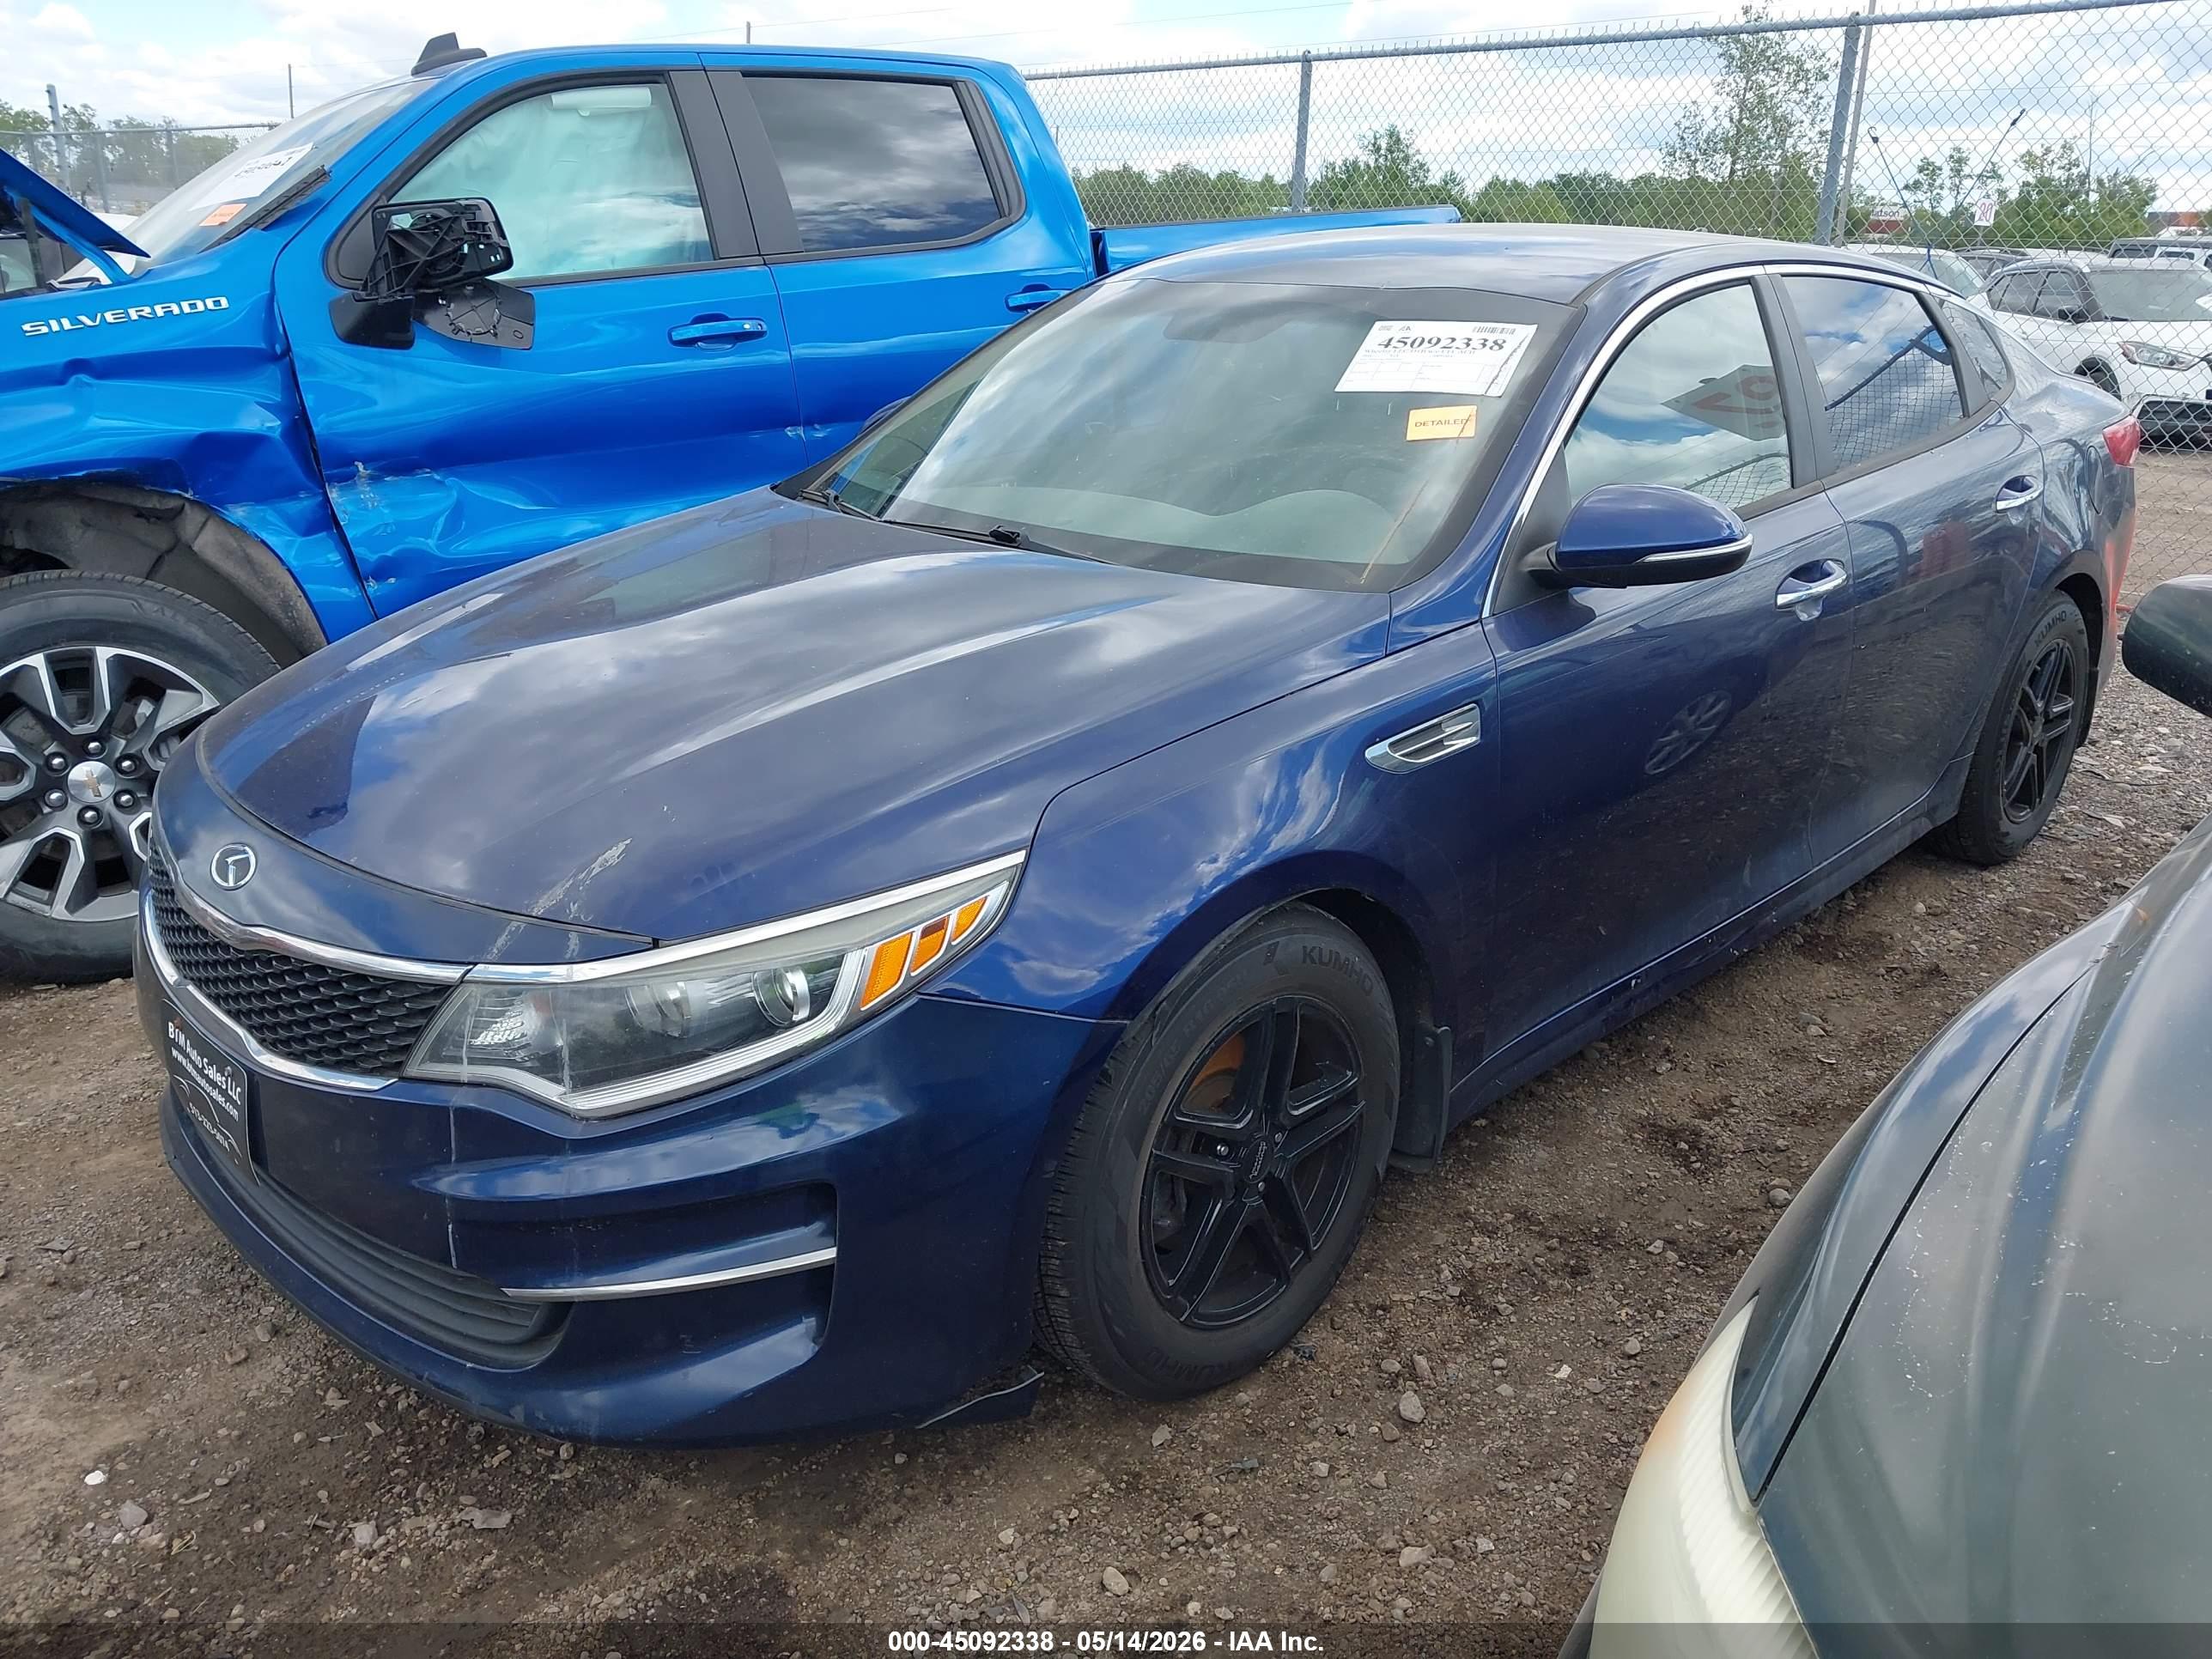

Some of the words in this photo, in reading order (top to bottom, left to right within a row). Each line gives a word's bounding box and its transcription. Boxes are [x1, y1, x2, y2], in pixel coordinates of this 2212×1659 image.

[21, 296, 230, 337] SILVERADO
[1377, 336, 1507, 351] 45092338
[1414, 418, 1469, 428] DETAILED
[1302, 945, 1374, 997] KUMHO
[185, 1038, 203, 1070] Auto
[203, 1059, 227, 1089] Sales
[227, 1075, 241, 1105] LLC
